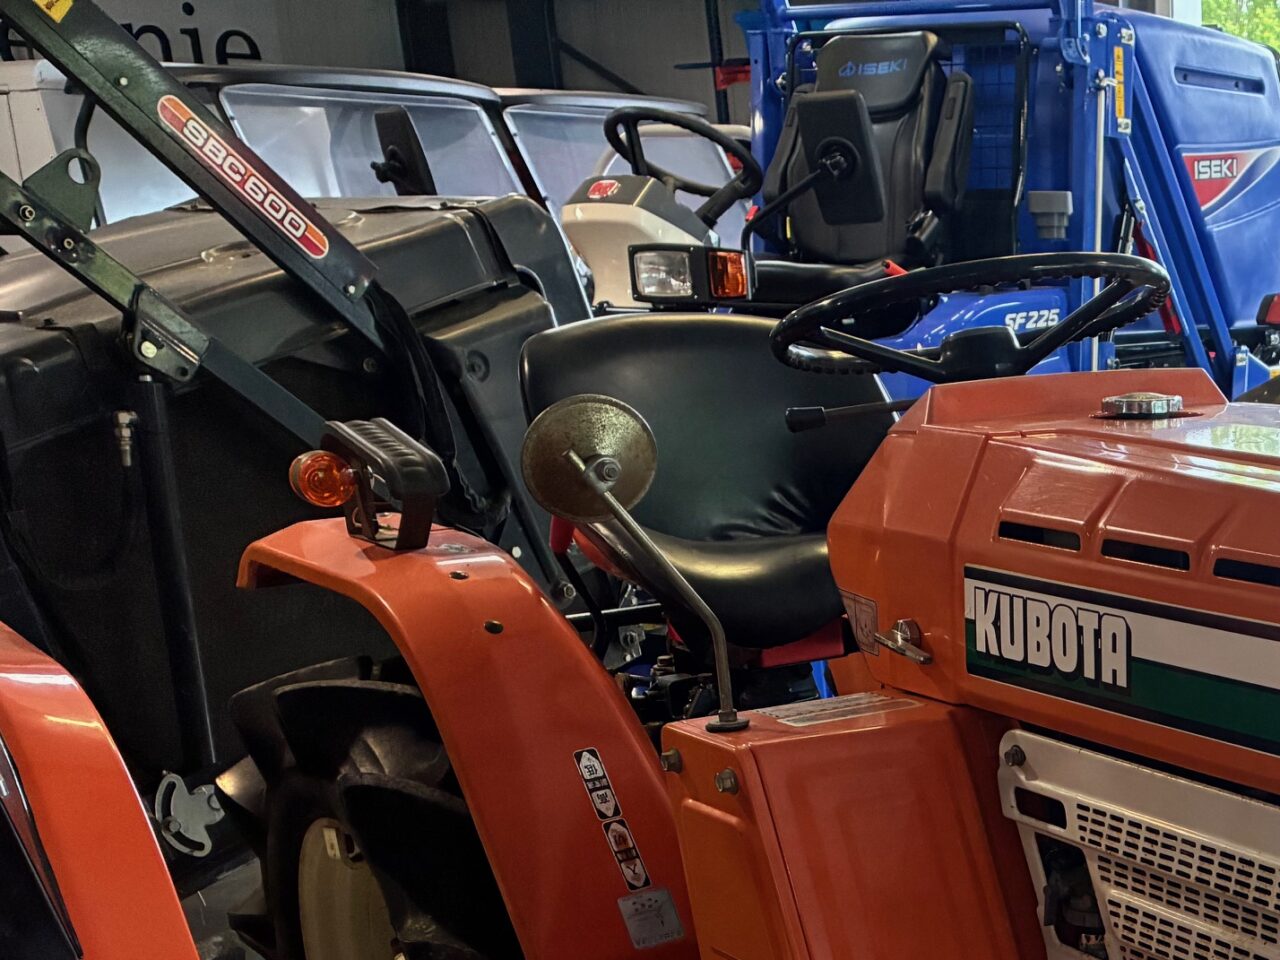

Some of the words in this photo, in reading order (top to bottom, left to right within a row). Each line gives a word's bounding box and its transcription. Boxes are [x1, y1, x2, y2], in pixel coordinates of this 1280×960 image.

[119, 2, 262, 64] nie
[858, 59, 908, 76] ISEKI
[183, 119, 246, 182] SBC
[244, 175, 307, 239] 600
[1194, 158, 1238, 180] ISEKI
[1005, 308, 1060, 330] SF225
[973, 586, 1132, 690] KUBOTA
